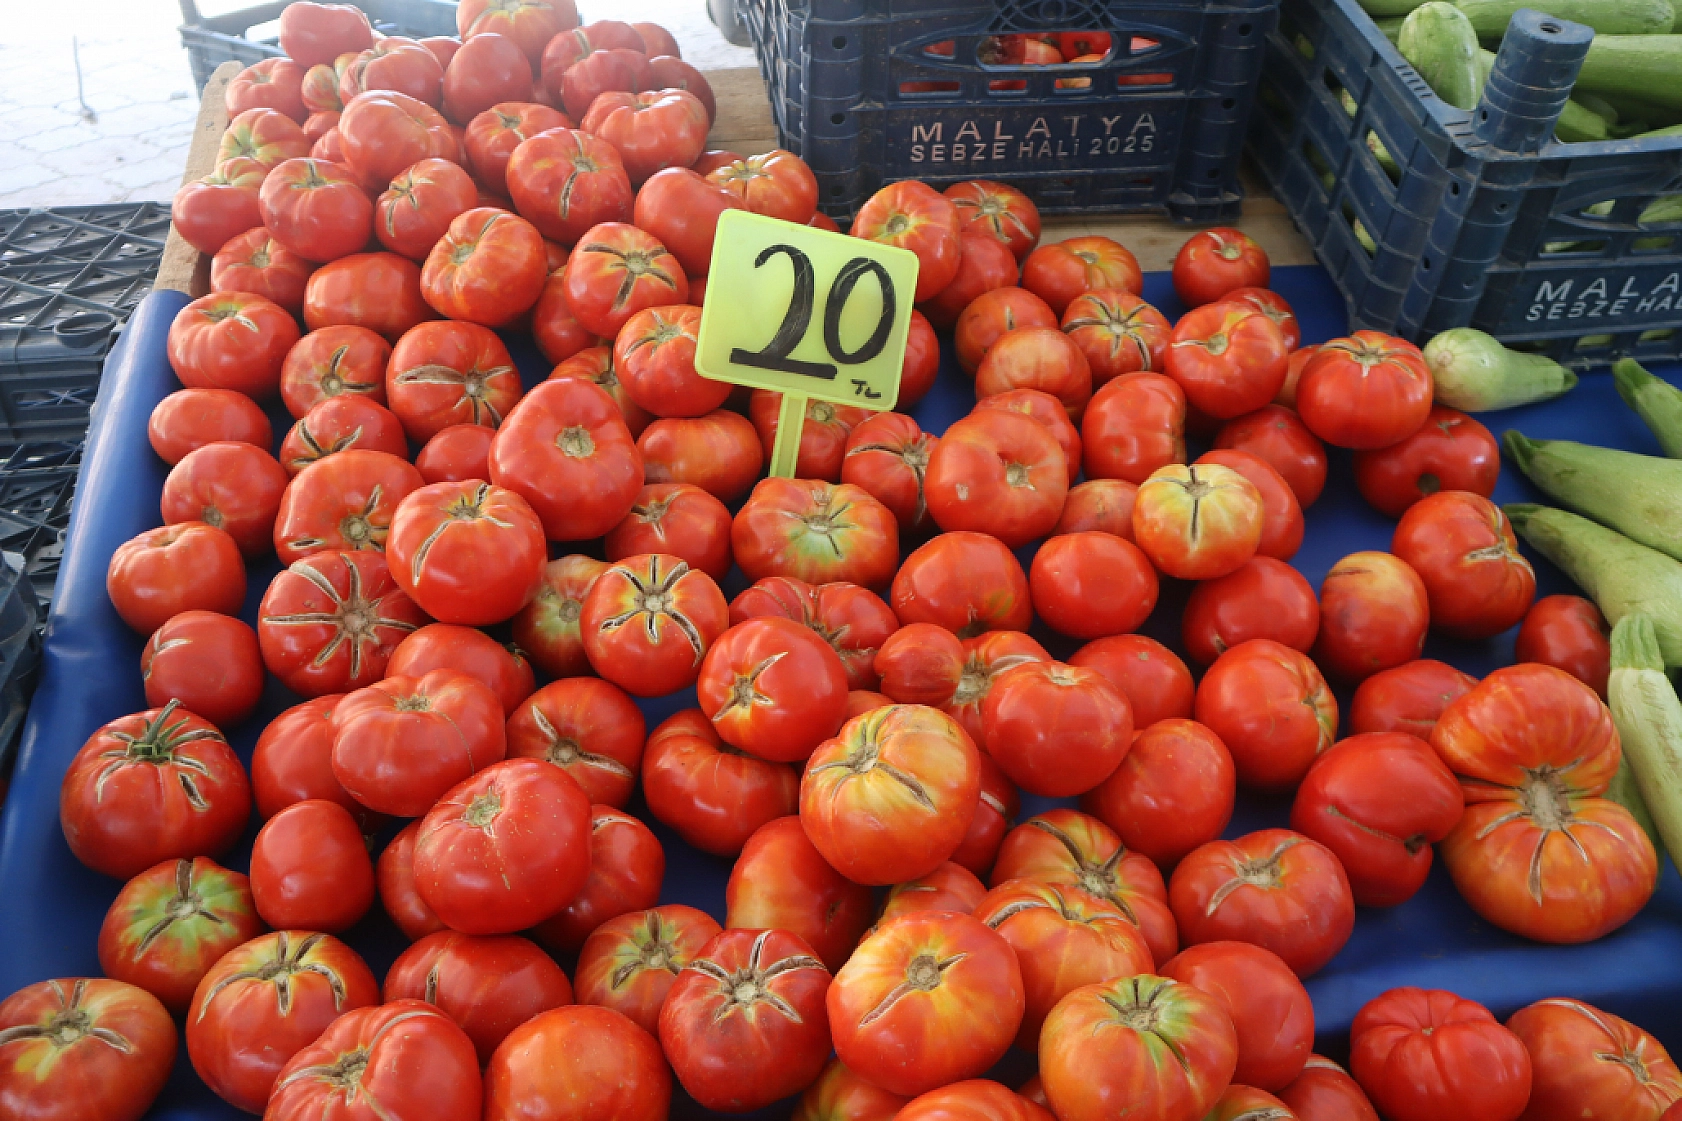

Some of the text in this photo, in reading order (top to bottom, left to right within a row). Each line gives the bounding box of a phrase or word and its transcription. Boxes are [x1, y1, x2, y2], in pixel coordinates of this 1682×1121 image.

[911, 113, 1157, 142] MALATYA
[910, 142, 1006, 162] SEBZE
[1089, 135, 1155, 154] 2025
[729, 244, 896, 380] 20
[851, 378, 882, 398] TL
